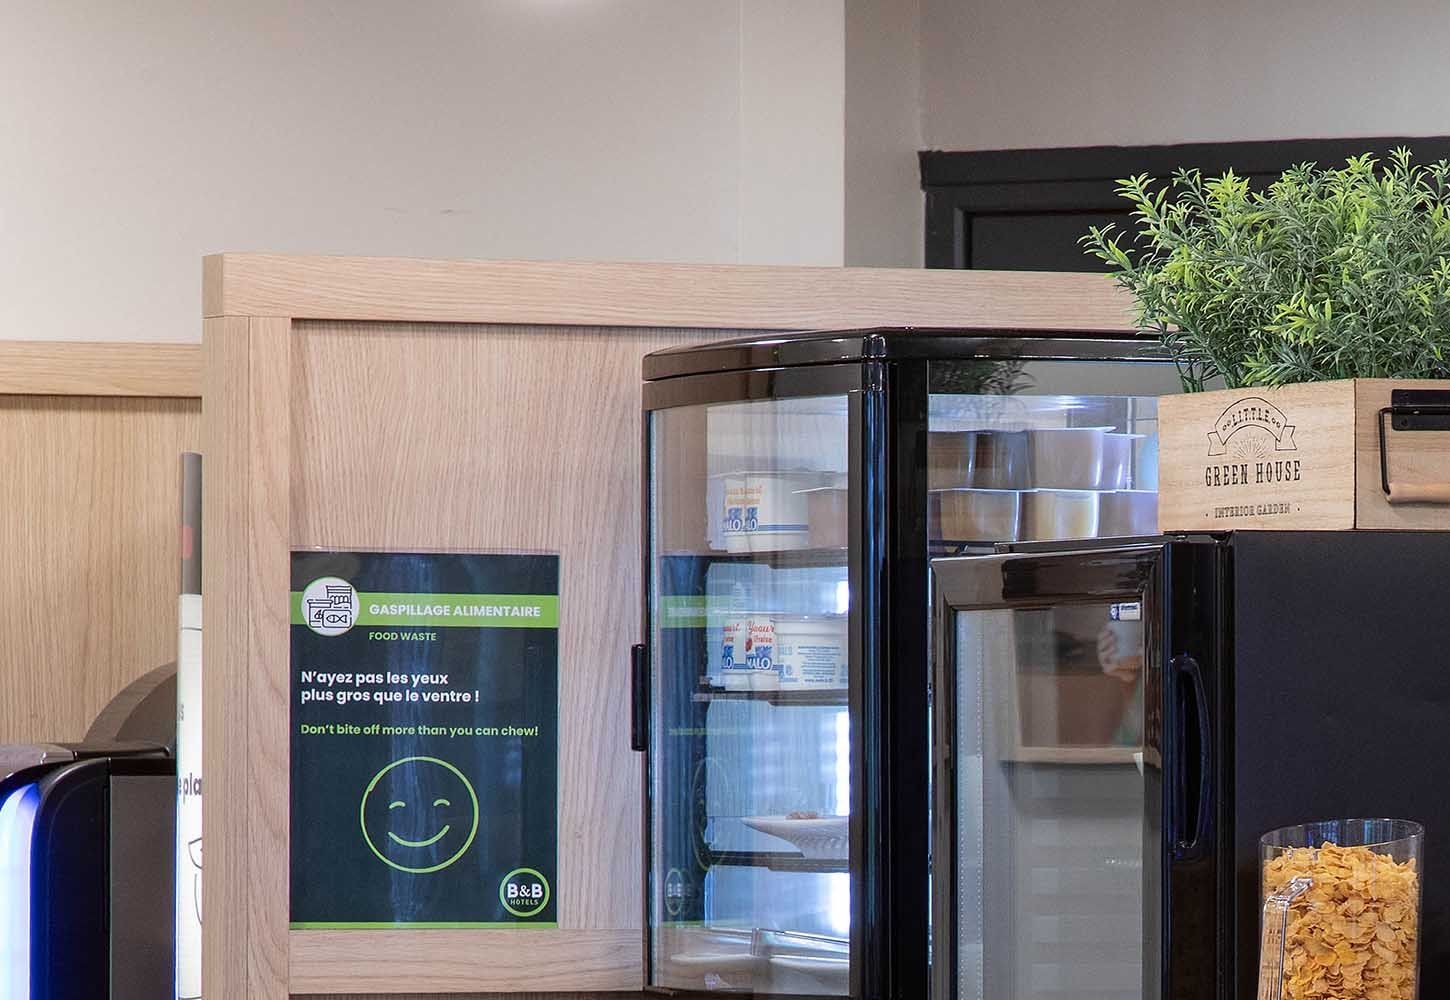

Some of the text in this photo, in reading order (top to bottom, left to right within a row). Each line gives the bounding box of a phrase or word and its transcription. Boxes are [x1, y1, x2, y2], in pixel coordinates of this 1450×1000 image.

[1231, 407, 1271, 428] LITTLE
[1205, 460, 1301, 487] GREEN HOUSE
[1214, 501, 1291, 519] INTERIOR GARDEN
[368, 604, 541, 617] GASPILLAGE ALIMENTAIRE
[368, 631, 437, 642] FOOD WASTE
[301, 671, 449, 688] N’ayez pas les yeux
[301, 688, 480, 705] plus gros que le ventre !
[336, 723, 362, 736] bite
[363, 723, 381, 736] off
[382, 726, 416, 736] more
[417, 724, 448, 736] than
[449, 727, 474, 738] you
[475, 727, 499, 737] can
[500, 725, 539, 737] chew!
[507, 883, 543, 898] B&B
